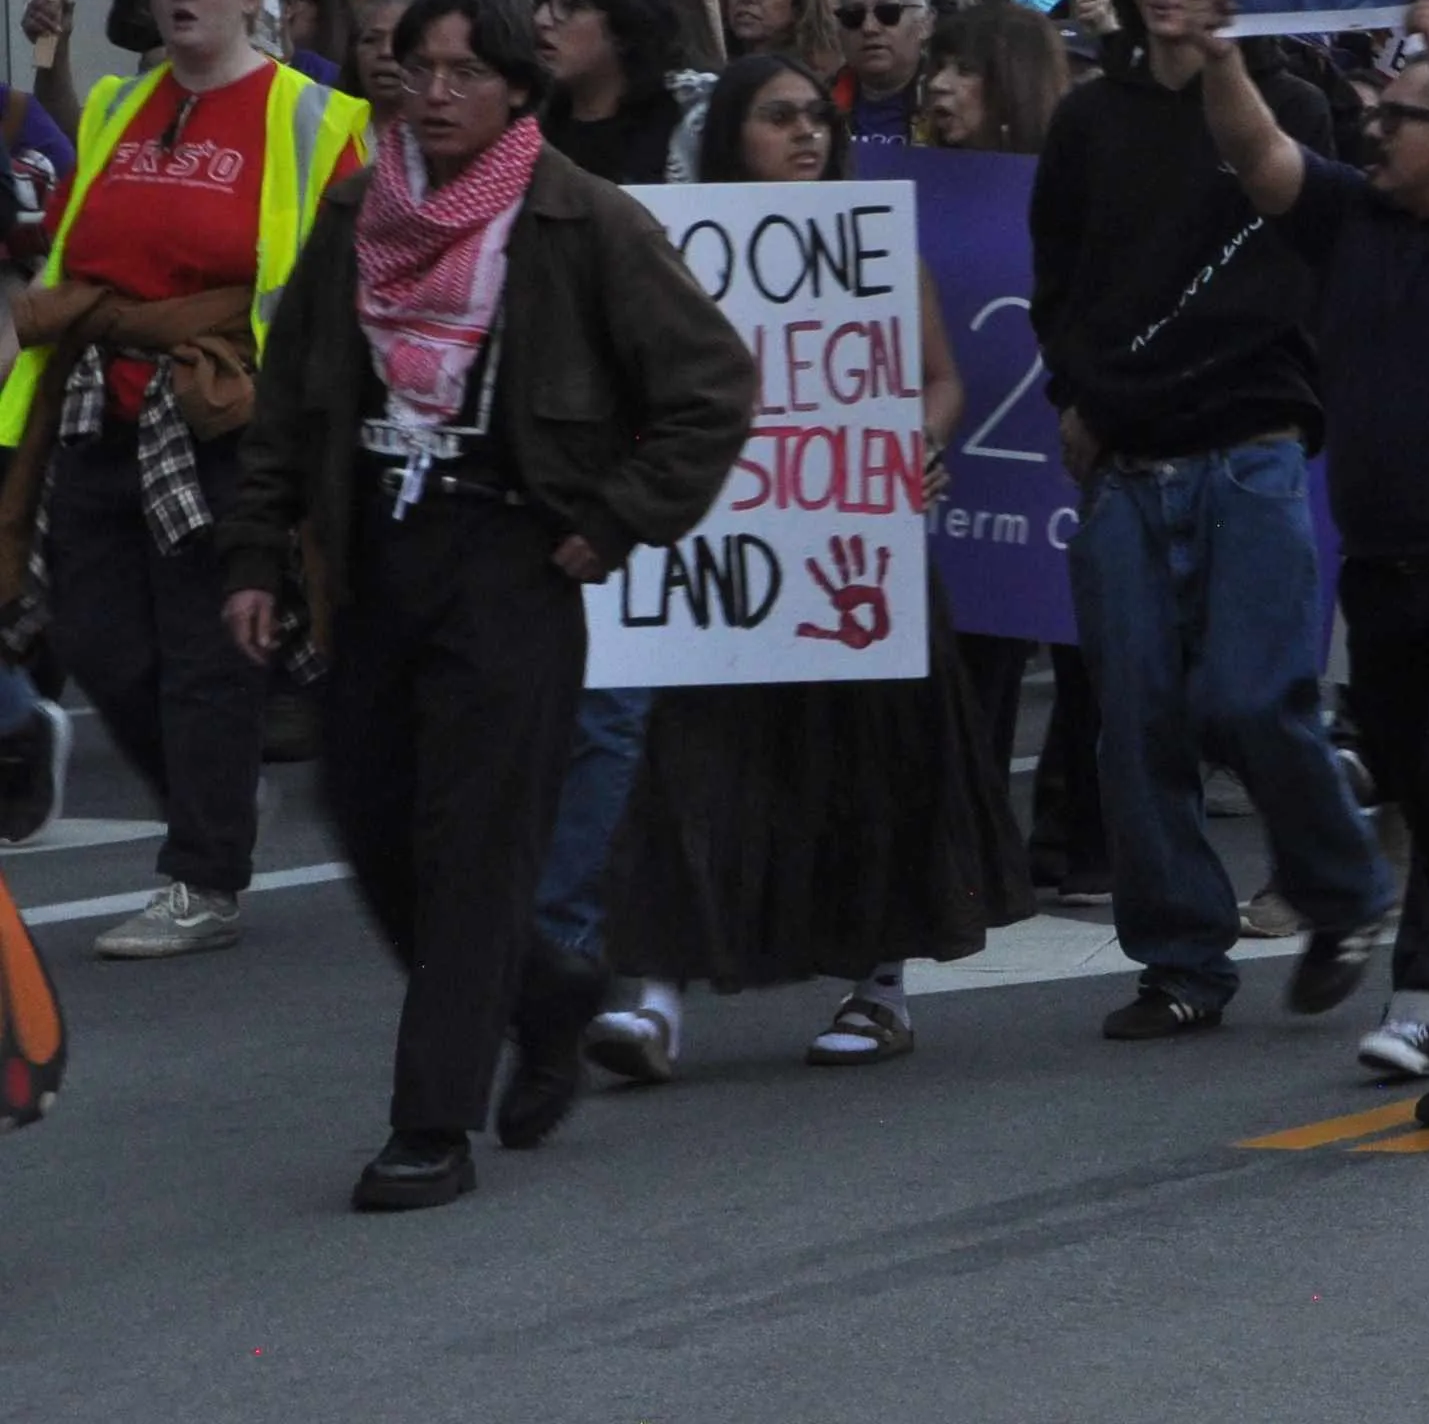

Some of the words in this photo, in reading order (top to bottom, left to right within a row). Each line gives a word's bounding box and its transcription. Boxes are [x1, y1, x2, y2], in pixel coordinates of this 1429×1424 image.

[748, 205, 892, 304] ONE
[732, 424, 925, 515] STOLEN
[622, 533, 782, 630] LAND
